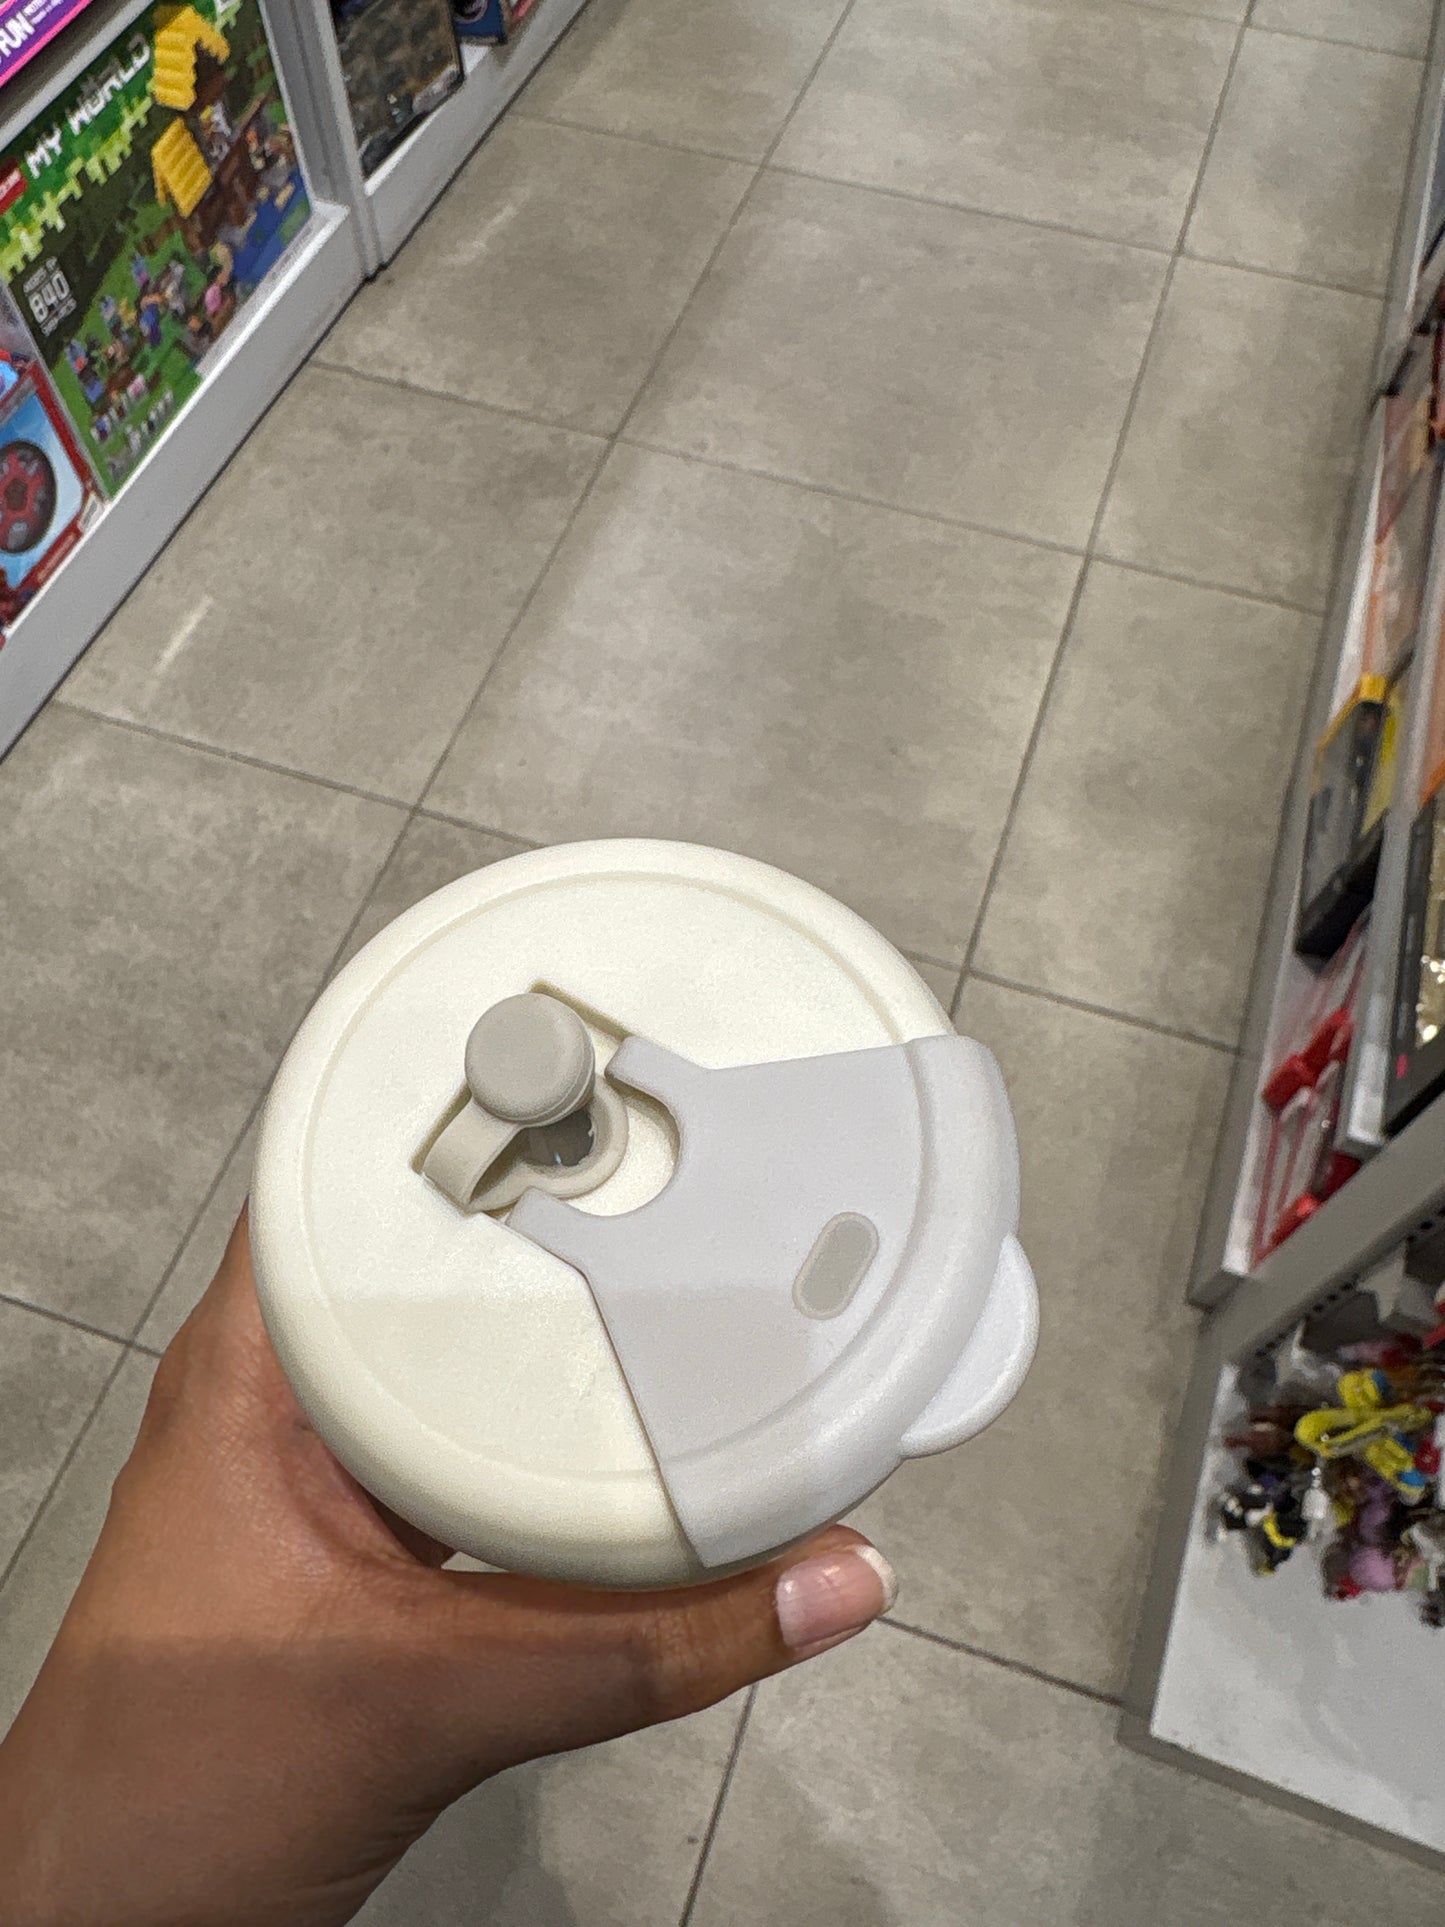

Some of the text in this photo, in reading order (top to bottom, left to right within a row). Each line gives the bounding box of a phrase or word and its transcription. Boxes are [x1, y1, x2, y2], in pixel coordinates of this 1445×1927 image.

[25, 32, 151, 179] MY WORLD
[28, 270, 70, 323] 840
